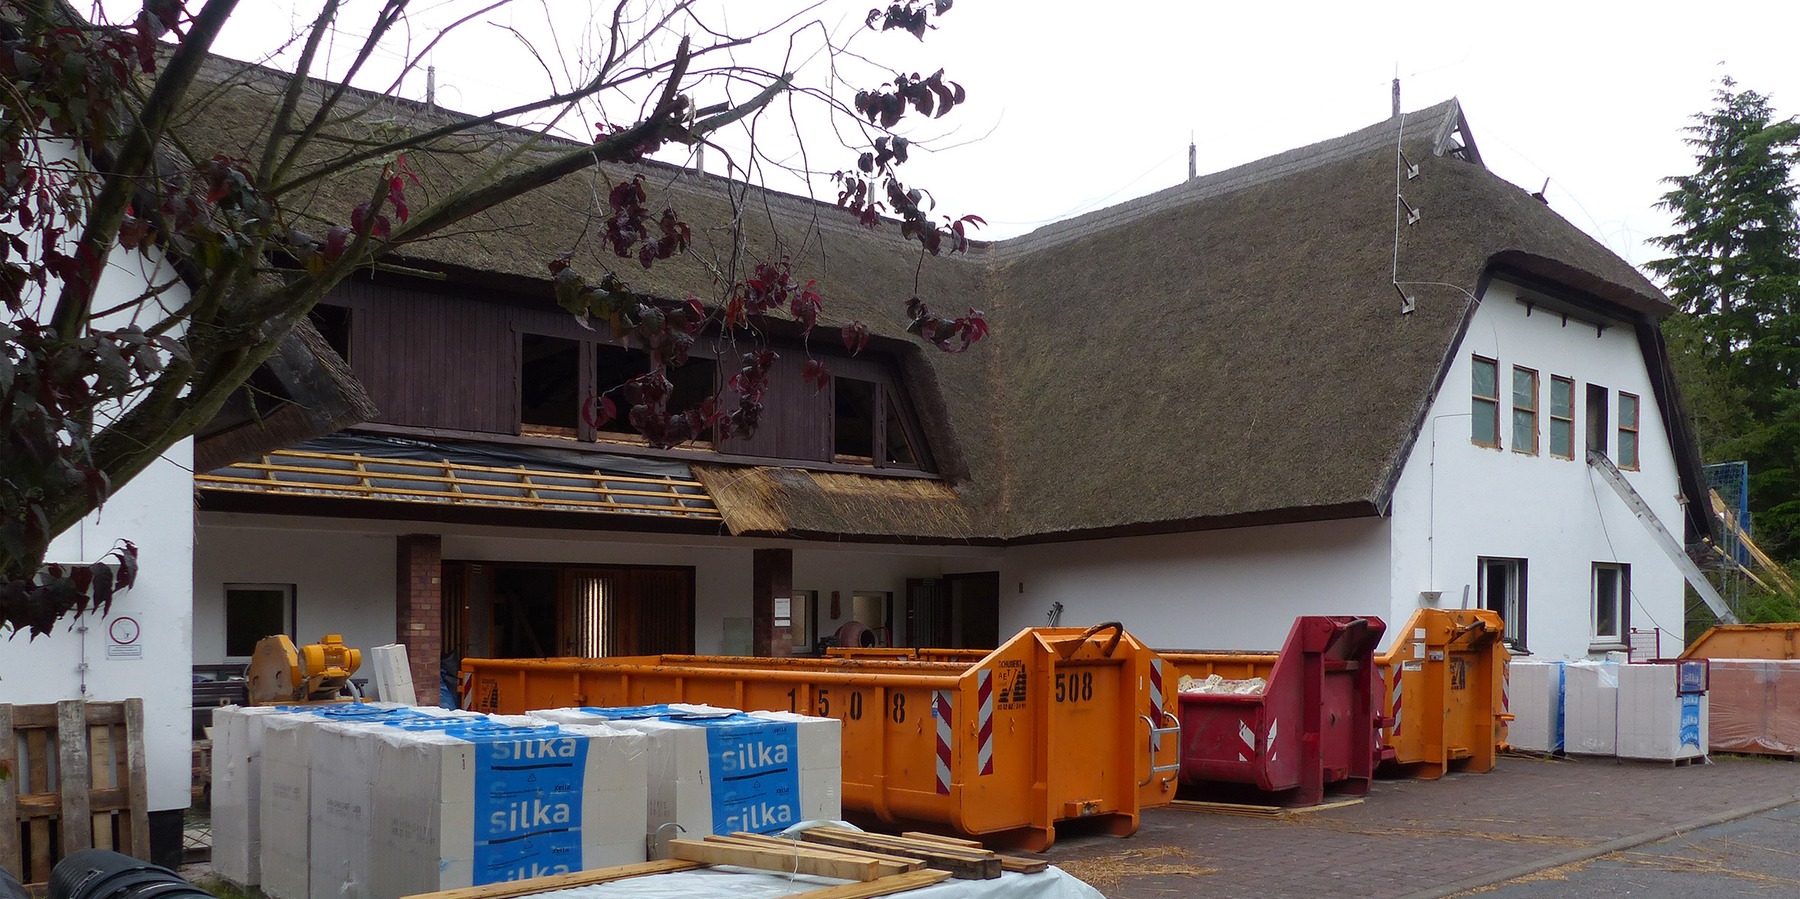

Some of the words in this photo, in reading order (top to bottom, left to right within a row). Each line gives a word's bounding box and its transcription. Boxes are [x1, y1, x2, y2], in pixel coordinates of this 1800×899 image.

[1055, 672, 1093, 703] 508
[722, 741, 788, 771] silka
[489, 799, 570, 834] silka
[726, 802, 792, 833] silka
